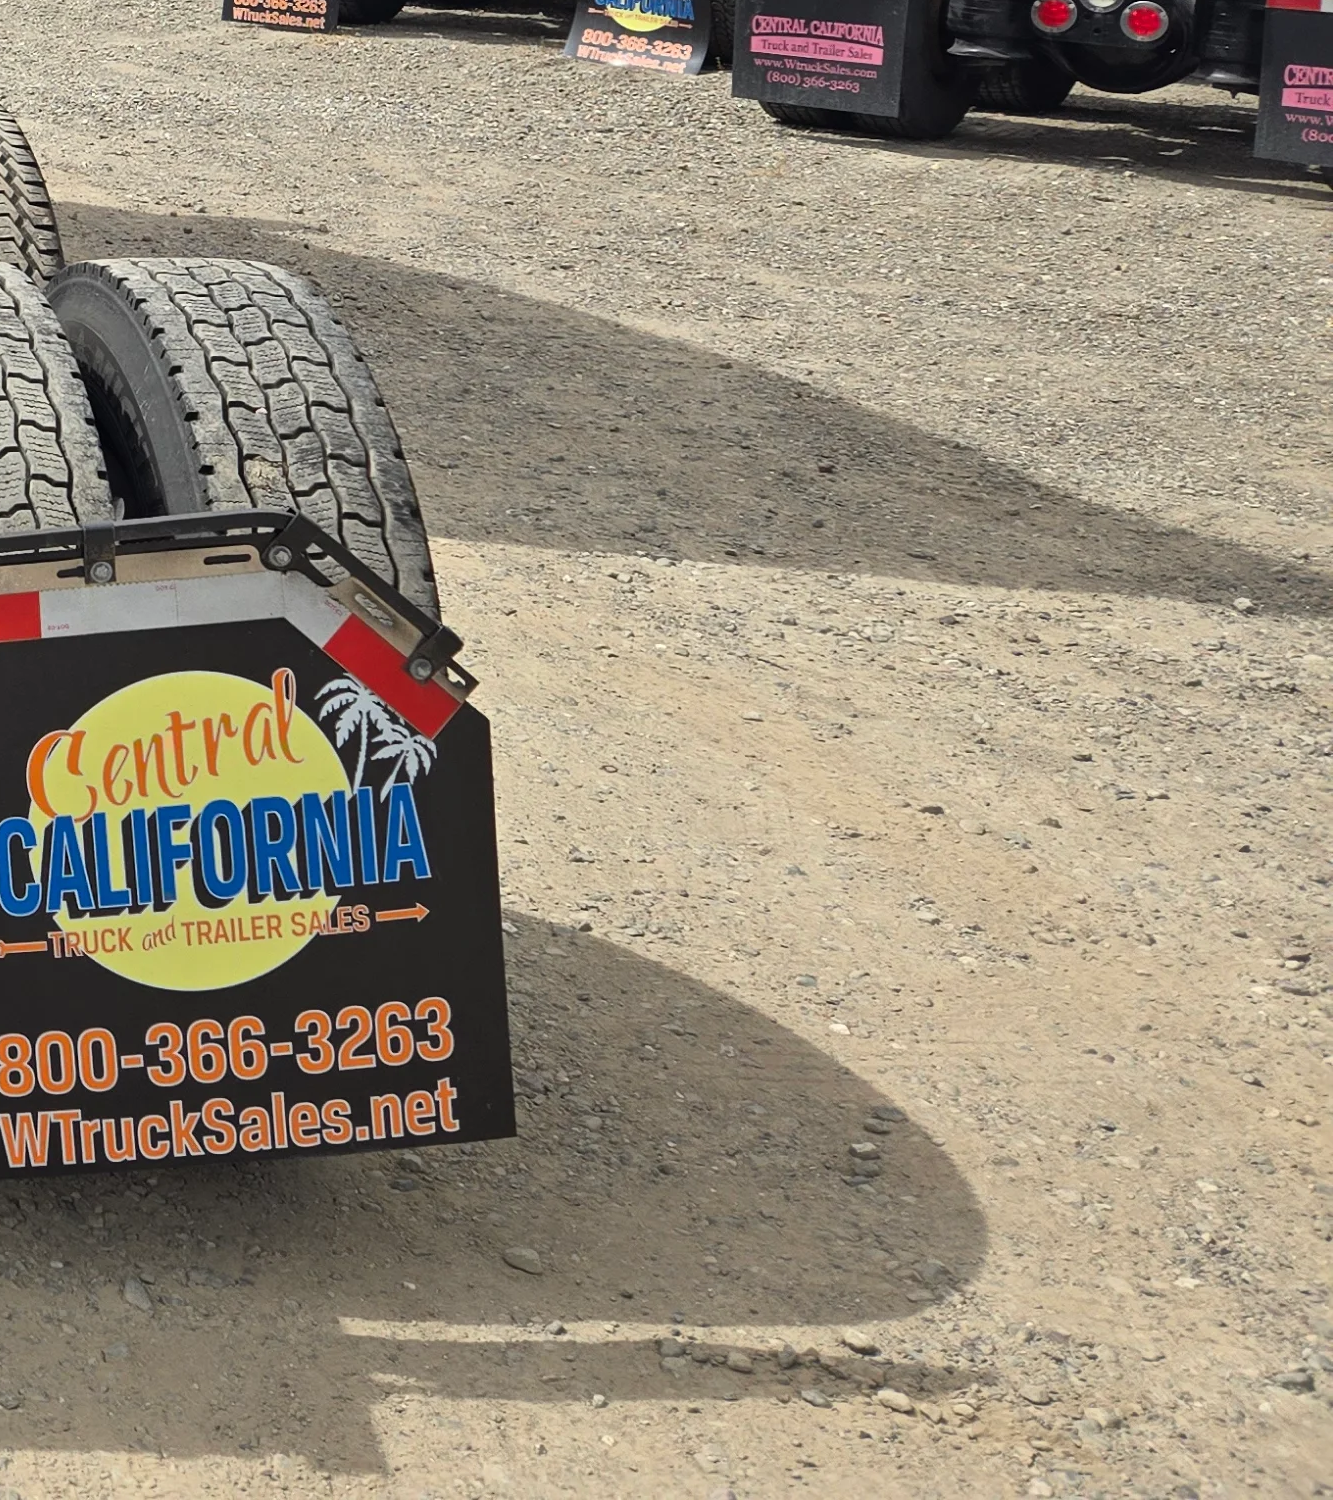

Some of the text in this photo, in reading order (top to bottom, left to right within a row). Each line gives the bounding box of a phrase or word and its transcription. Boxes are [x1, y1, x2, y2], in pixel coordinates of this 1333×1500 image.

[232, 6, 326, 30] WTruckSales.net
[752, 15, 884, 47] CENTRAL CALIFORNIA
[581, 28, 693, 61] 800-366-3263
[761, 39, 873, 60] Truck and Trailer Sales
[754, 58, 877, 79] www.WtruckSales.com
[766, 70, 860, 94] (800) 366-3263
[1295, 92, 1331, 106] Truck
[26, 666, 305, 824] Central
[47, 904, 371, 959] TRUCK and TRAILER SALES
